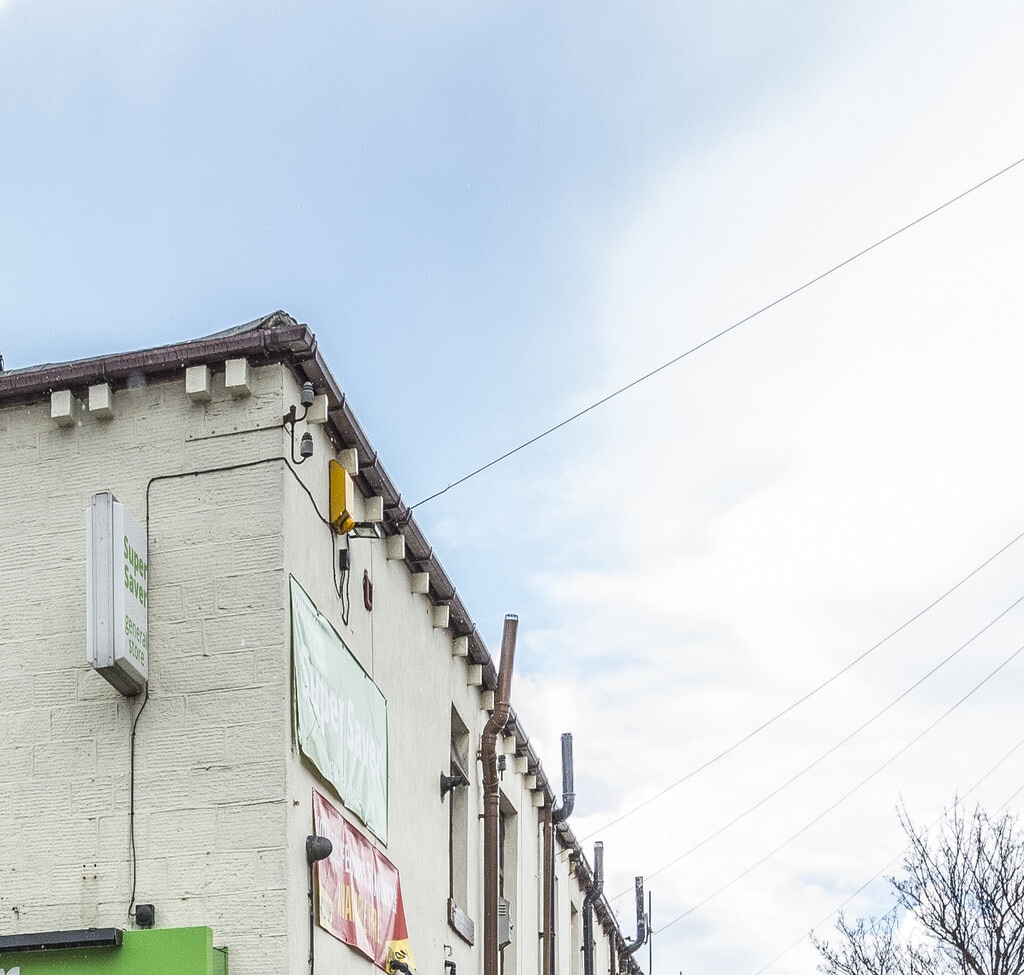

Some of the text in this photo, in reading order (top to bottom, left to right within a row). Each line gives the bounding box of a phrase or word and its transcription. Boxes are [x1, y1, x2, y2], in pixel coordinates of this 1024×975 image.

[124, 535, 147, 580] Super
[124, 564, 146, 608] Saver
[125, 614, 148, 648] general
[128, 639, 144, 666] store
